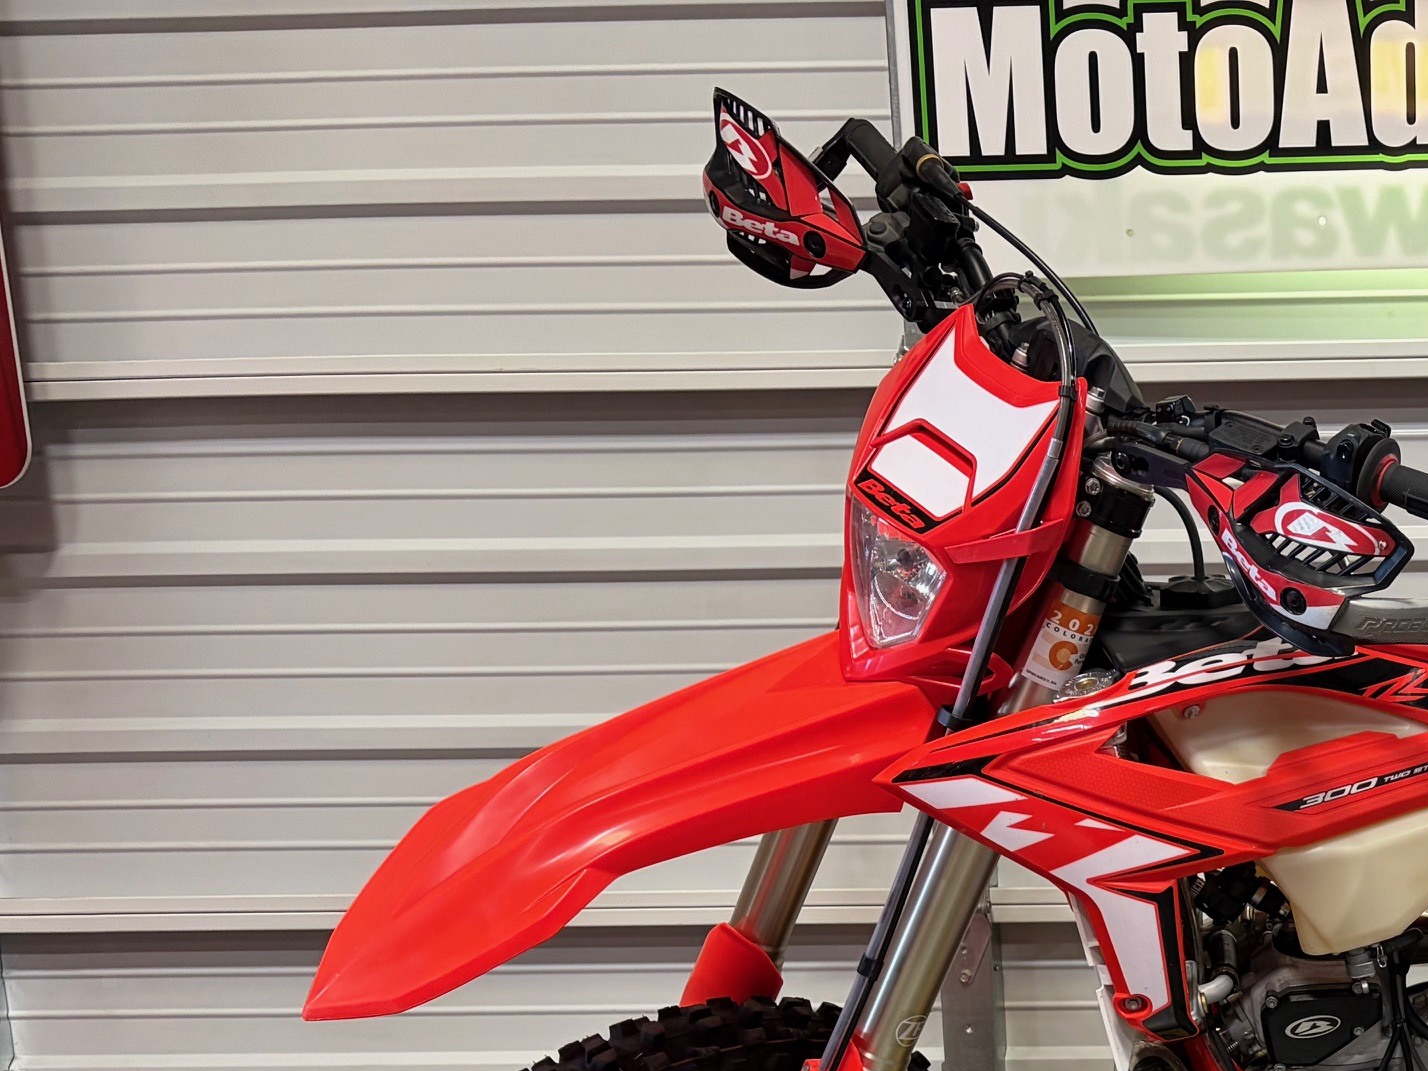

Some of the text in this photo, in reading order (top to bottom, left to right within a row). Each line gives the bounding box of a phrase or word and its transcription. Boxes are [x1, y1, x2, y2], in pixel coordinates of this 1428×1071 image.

[722, 205, 800, 247] Beta
[857, 478, 926, 529] Beta
[1220, 527, 1278, 602] Beta
[1300, 776, 1379, 809] 300
[1383, 770, 1412, 784] TWO
